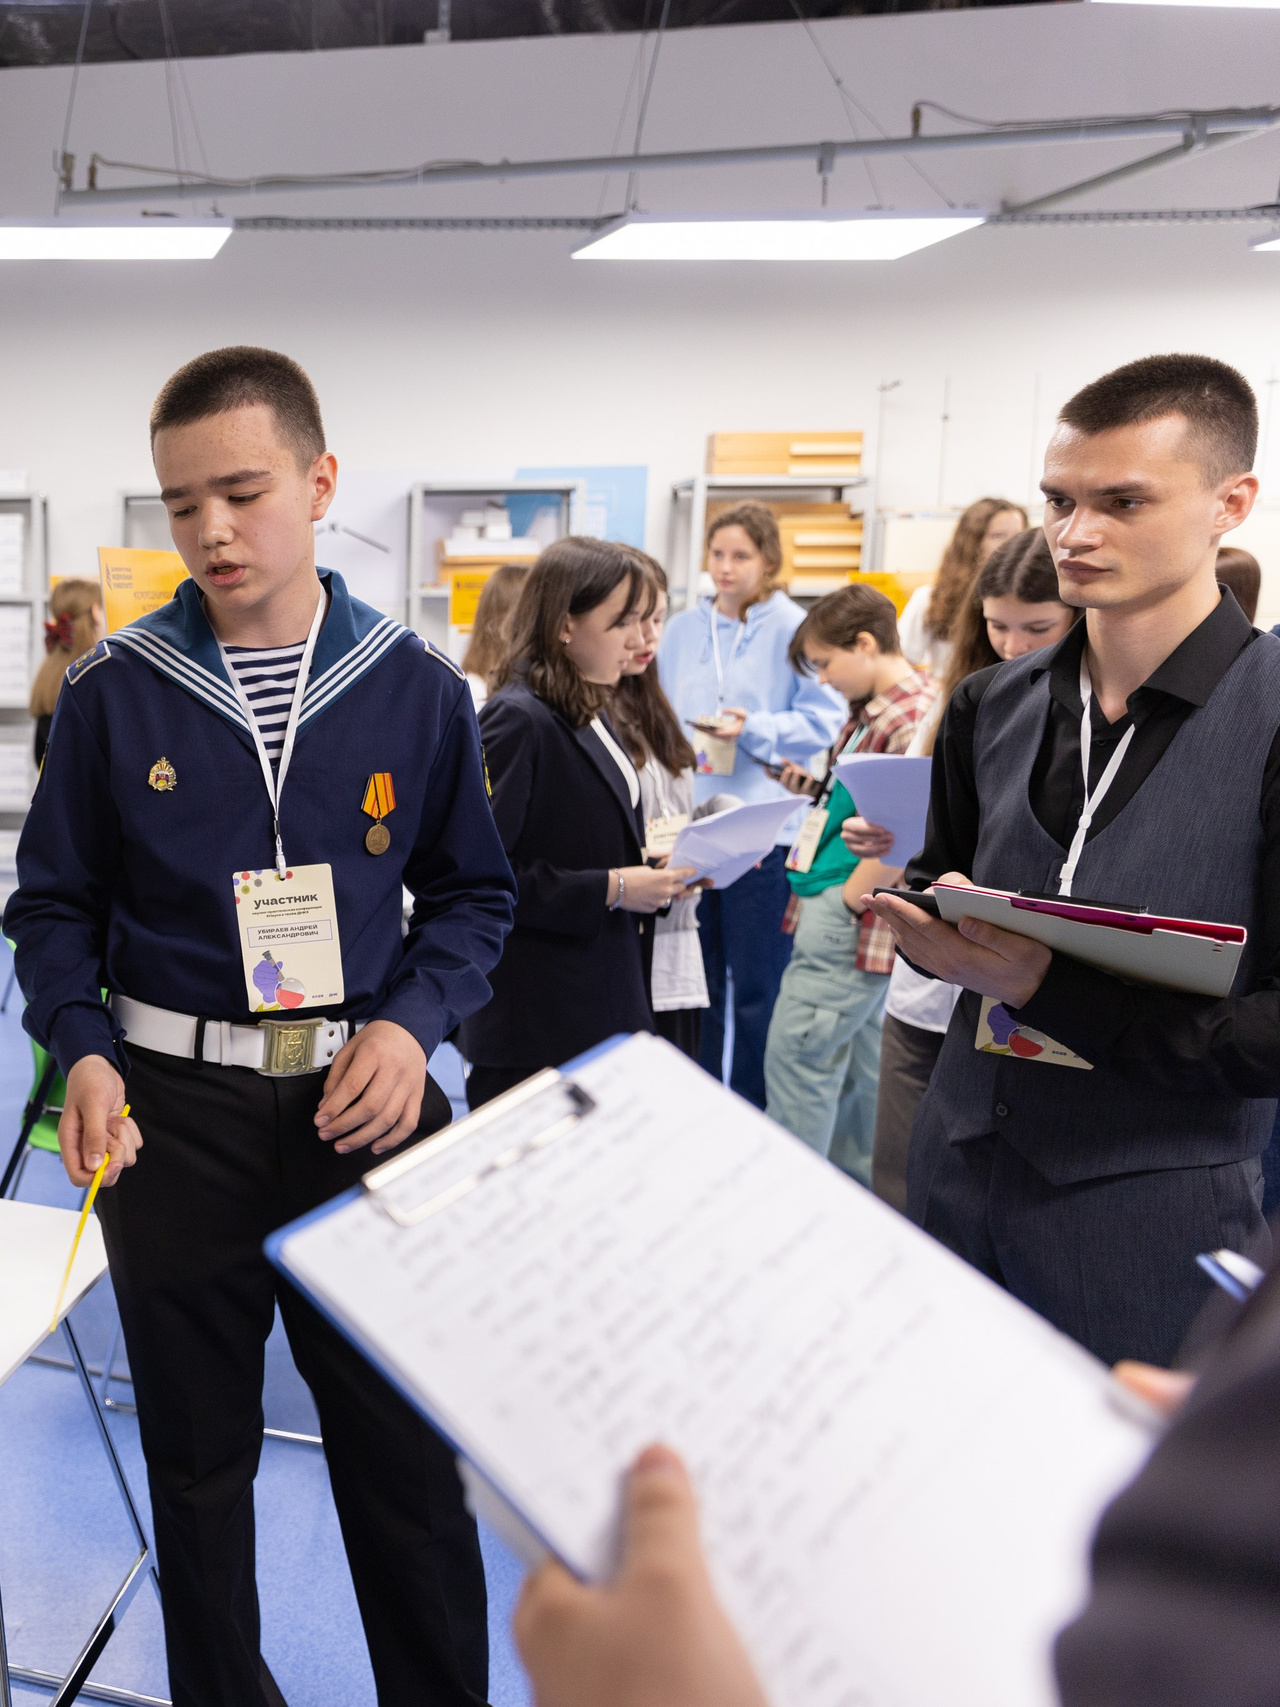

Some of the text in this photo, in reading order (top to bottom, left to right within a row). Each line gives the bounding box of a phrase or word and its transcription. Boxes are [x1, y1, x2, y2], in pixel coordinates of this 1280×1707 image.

[254, 894, 318, 910] участник
[290, 924, 318, 932] АНДРЕЙ
[258, 931, 319, 940] АЛЕКСАНДРОВИЧ
